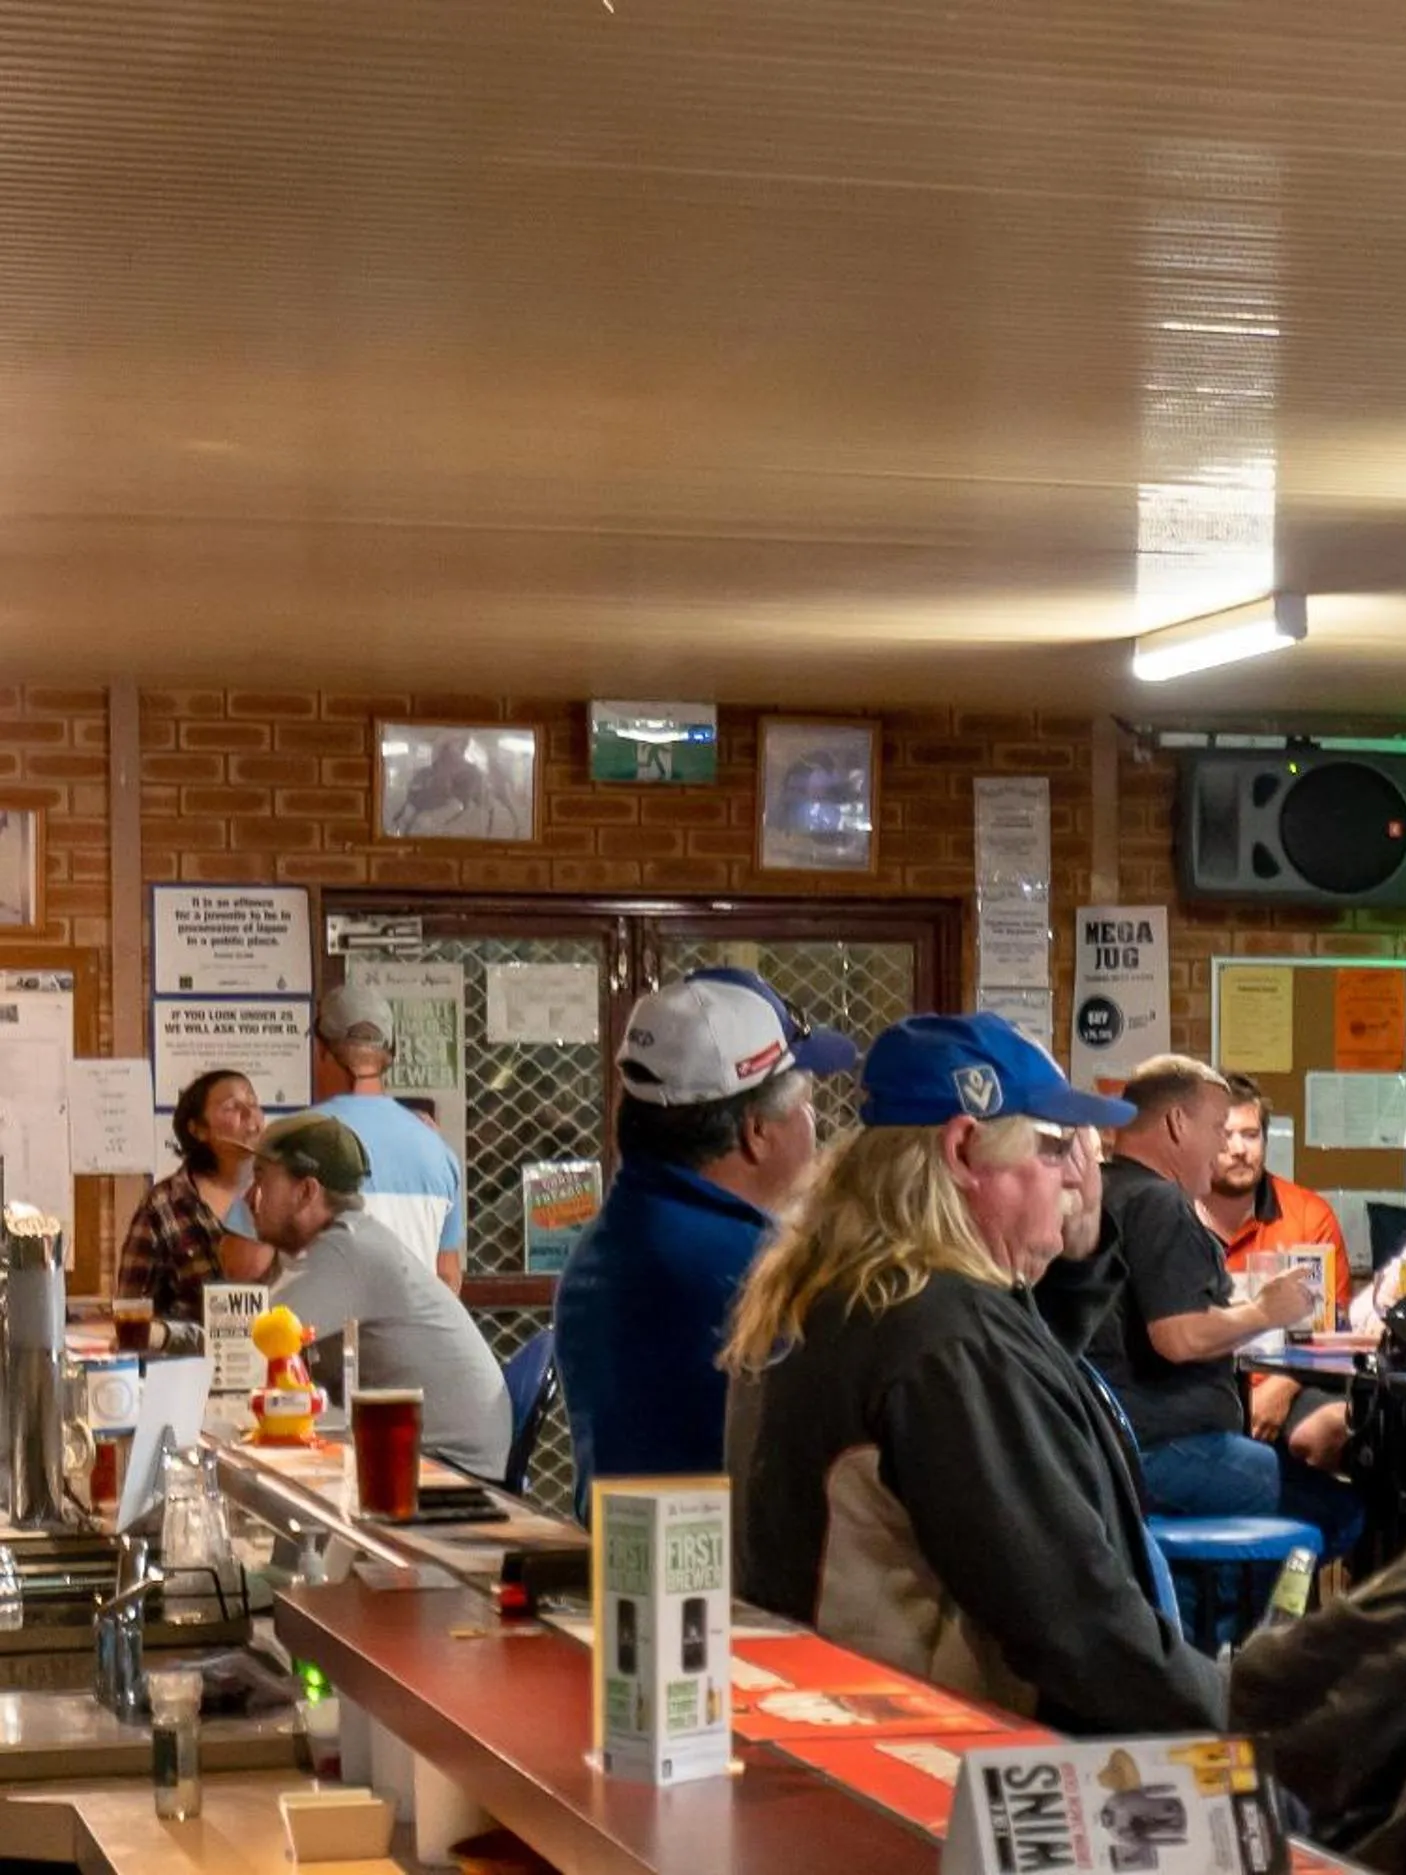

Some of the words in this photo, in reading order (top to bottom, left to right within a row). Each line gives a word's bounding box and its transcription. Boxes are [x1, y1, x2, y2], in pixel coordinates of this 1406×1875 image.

[1094, 946, 1140, 970] JUG
[183, 1010, 206, 1021] YOU
[208, 1010, 237, 1021] LOOK
[164, 1023, 181, 1034] WE
[184, 1023, 211, 1034] WILL
[213, 1023, 235, 1034] ASK
[238, 1023, 260, 1034] YOU
[228, 1291, 263, 1316] WIN
[666, 1533, 723, 1571] FIRST
[1003, 1763, 1077, 1873] WINS
